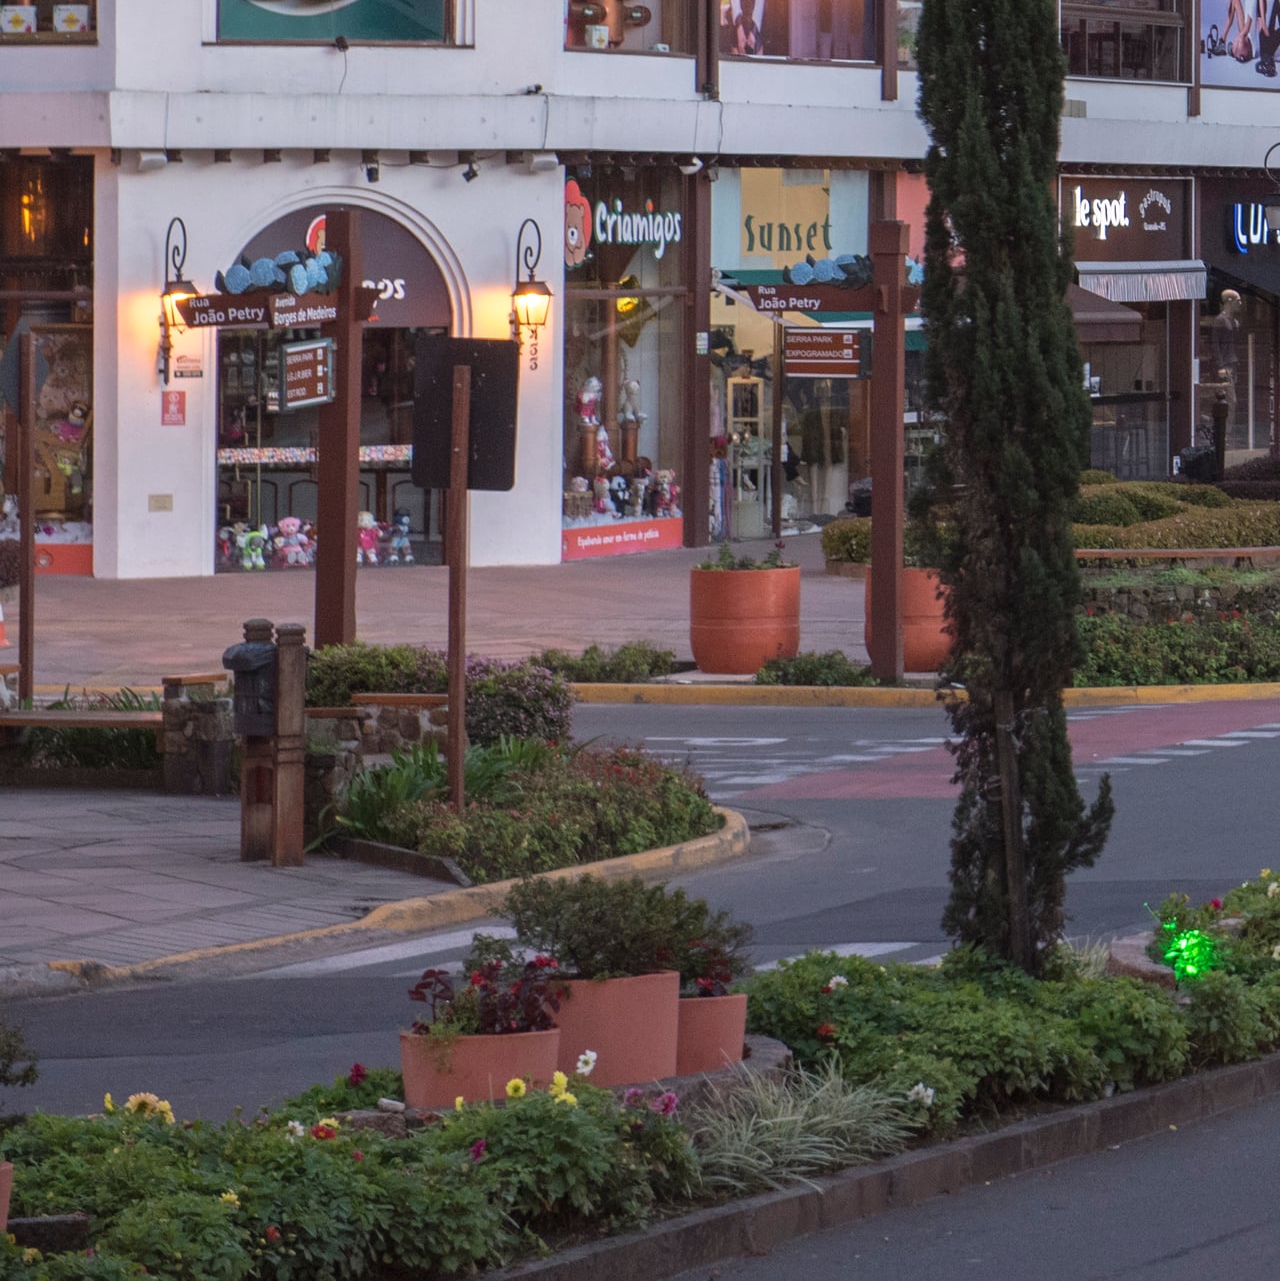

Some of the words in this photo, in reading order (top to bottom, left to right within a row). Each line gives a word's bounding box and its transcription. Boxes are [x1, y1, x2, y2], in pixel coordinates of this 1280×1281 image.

[1074, 185, 1090, 227] le
[1093, 190, 1129, 240] spot.
[595, 199, 682, 259] Criamigos
[744, 213, 832, 252] Sunset
[758, 285, 776, 295] Rua
[189, 297, 210, 309] Rua
[275, 295, 296, 308] Avenida
[758, 297, 787, 309] João
[789, 297, 821, 310] Petry
[193, 309, 226, 326] João
[228, 306, 265, 322] Petry
[274, 311, 298, 327] Borges
[298, 310, 307, 322] de
[307, 306, 337, 321] Medeiros
[786, 335, 811, 343] SERRA
[813, 335, 833, 343] PARK
